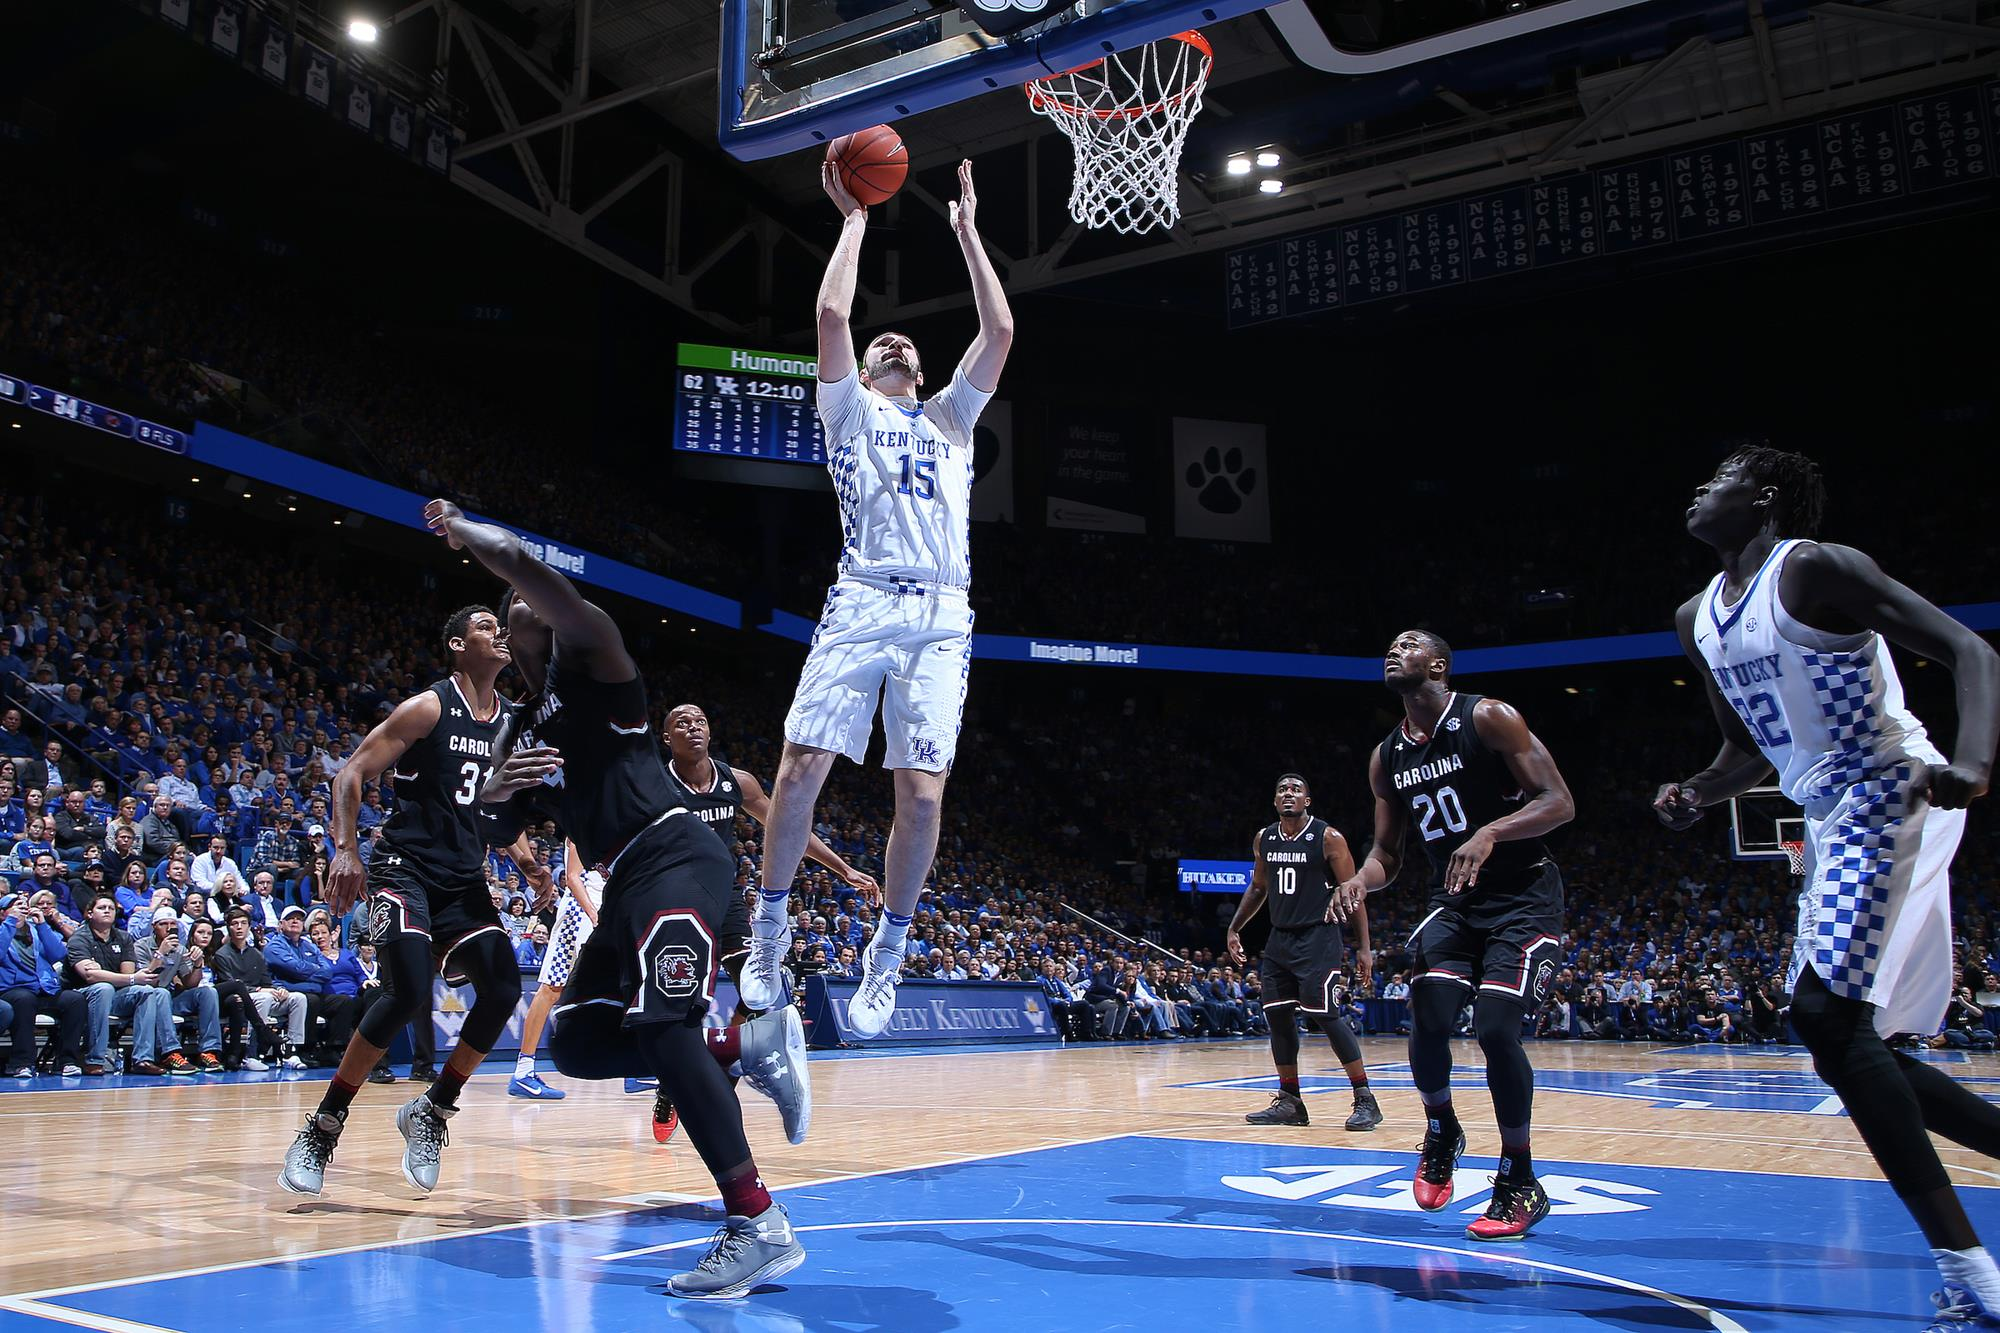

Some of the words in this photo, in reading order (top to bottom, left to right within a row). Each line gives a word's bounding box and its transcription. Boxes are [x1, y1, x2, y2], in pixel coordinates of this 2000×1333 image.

[1823, 123, 1847, 187] NCAA
[1877, 130, 1899, 192] 1993
[1904, 103, 1931, 169] NCAA
[1935, 102, 1960, 178] CHAMPION
[1962, 111, 1984, 174] 1996
[1626, 172, 1642, 218] RUNNER
[1674, 158, 1696, 218] NCAA
[1700, 154, 1720, 226] CHAMPION
[1722, 162, 1743, 222] 1978
[1748, 140, 1771, 203] NCAA
[1800, 148, 1821, 208] 1984
[1469, 201, 1487, 260] NCAA
[1532, 187, 1552, 247] NCAA
[1556, 186, 1572, 234] RUNNER
[1579, 197, 1596, 254] 1966
[1601, 172, 1621, 233] NCAA
[1649, 181, 1666, 240] 1975
[1344, 229, 1361, 286] NCAA
[1366, 227, 1382, 294] CHAMPION
[1402, 214, 1421, 272] NCAA
[1427, 214, 1443, 281] CHAMPION
[1447, 224, 1461, 280] 1951
[1491, 201, 1508, 269] CHAMPION
[1512, 208, 1528, 266] 1958
[1229, 255, 1243, 310] NCAA
[1265, 262, 1279, 315] 1942
[1286, 240, 1301, 296] NCAA
[1306, 240, 1320, 305] CHAMPION
[1324, 249, 1339, 302] 1948
[1383, 239, 1399, 292] 1949
[53, 394, 78, 419] 54
[684, 375, 704, 390] 62
[746, 381, 806, 400] 12:10
[897, 454, 936, 500] 15
[545, 544, 586, 575] More!
[1030, 642, 1093, 661] Imagine
[1094, 646, 1138, 664] More!
[1711, 653, 1783, 690] NUCKY
[449, 734, 494, 758] CAROL
[912, 737, 941, 766] UK
[1394, 753, 1464, 790] CAROLINA
[693, 804, 735, 824] OLINA
[1412, 785, 1468, 842] 20
[1266, 851, 1307, 864] CAROLINA
[1277, 867, 1297, 895] 10
[831, 998, 930, 1037] UUELY
[929, 999, 1021, 1031] KENTUCKY
